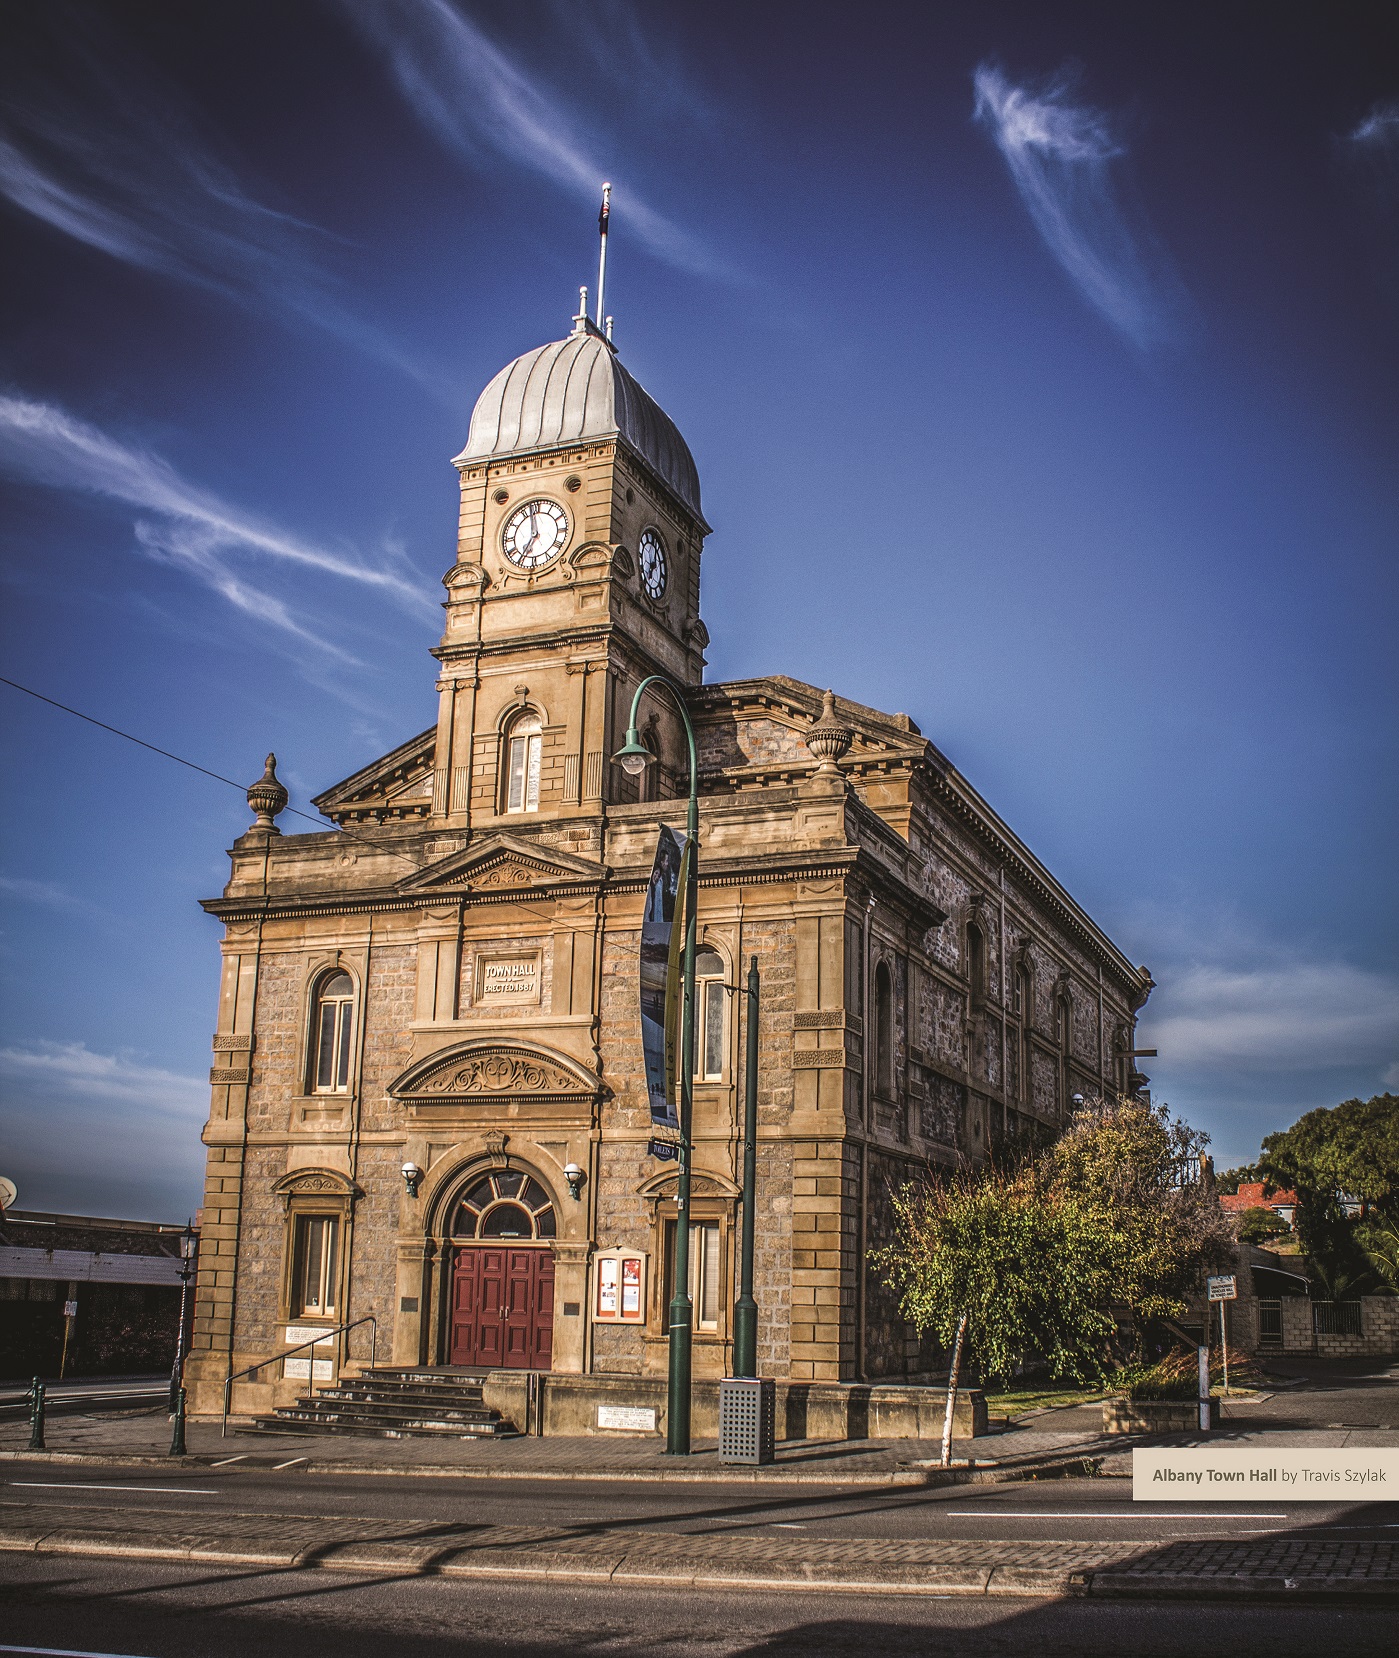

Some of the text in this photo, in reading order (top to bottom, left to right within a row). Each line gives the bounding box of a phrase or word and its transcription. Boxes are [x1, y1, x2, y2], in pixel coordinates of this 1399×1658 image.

[485, 963, 535, 978] TOWN HALL
[665, 1041, 675, 1096] relax
